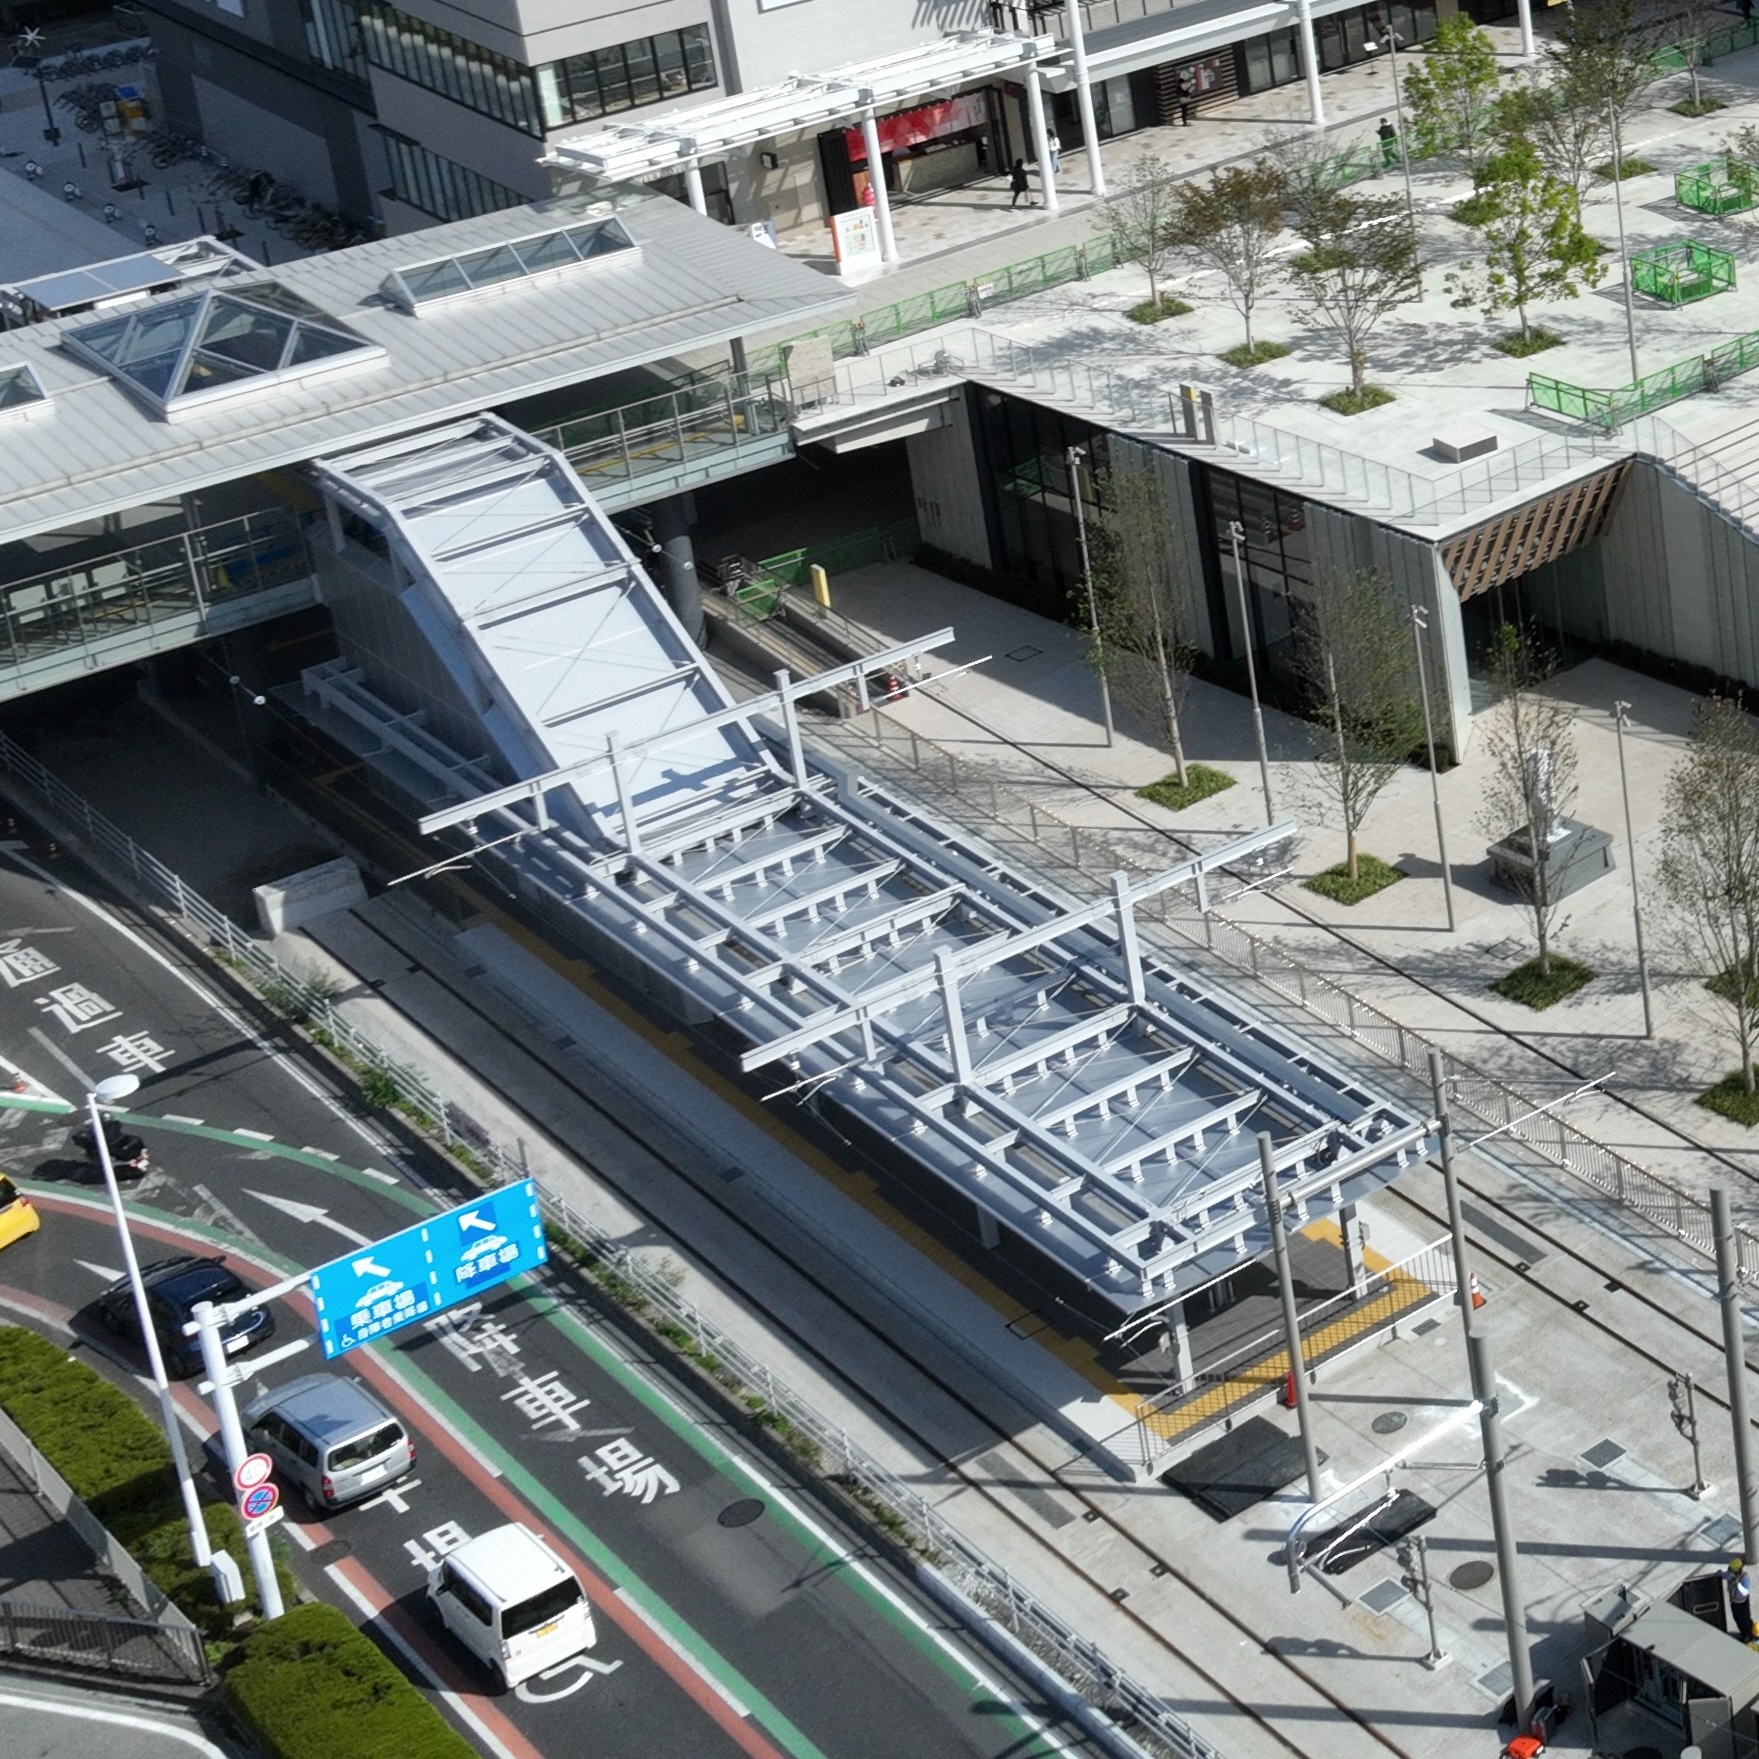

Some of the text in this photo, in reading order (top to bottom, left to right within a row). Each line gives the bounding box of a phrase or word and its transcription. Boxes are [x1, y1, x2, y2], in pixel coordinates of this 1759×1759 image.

[455, 1243, 520, 1284] 降車場
[350, 1289, 416, 1331] 乗車場
